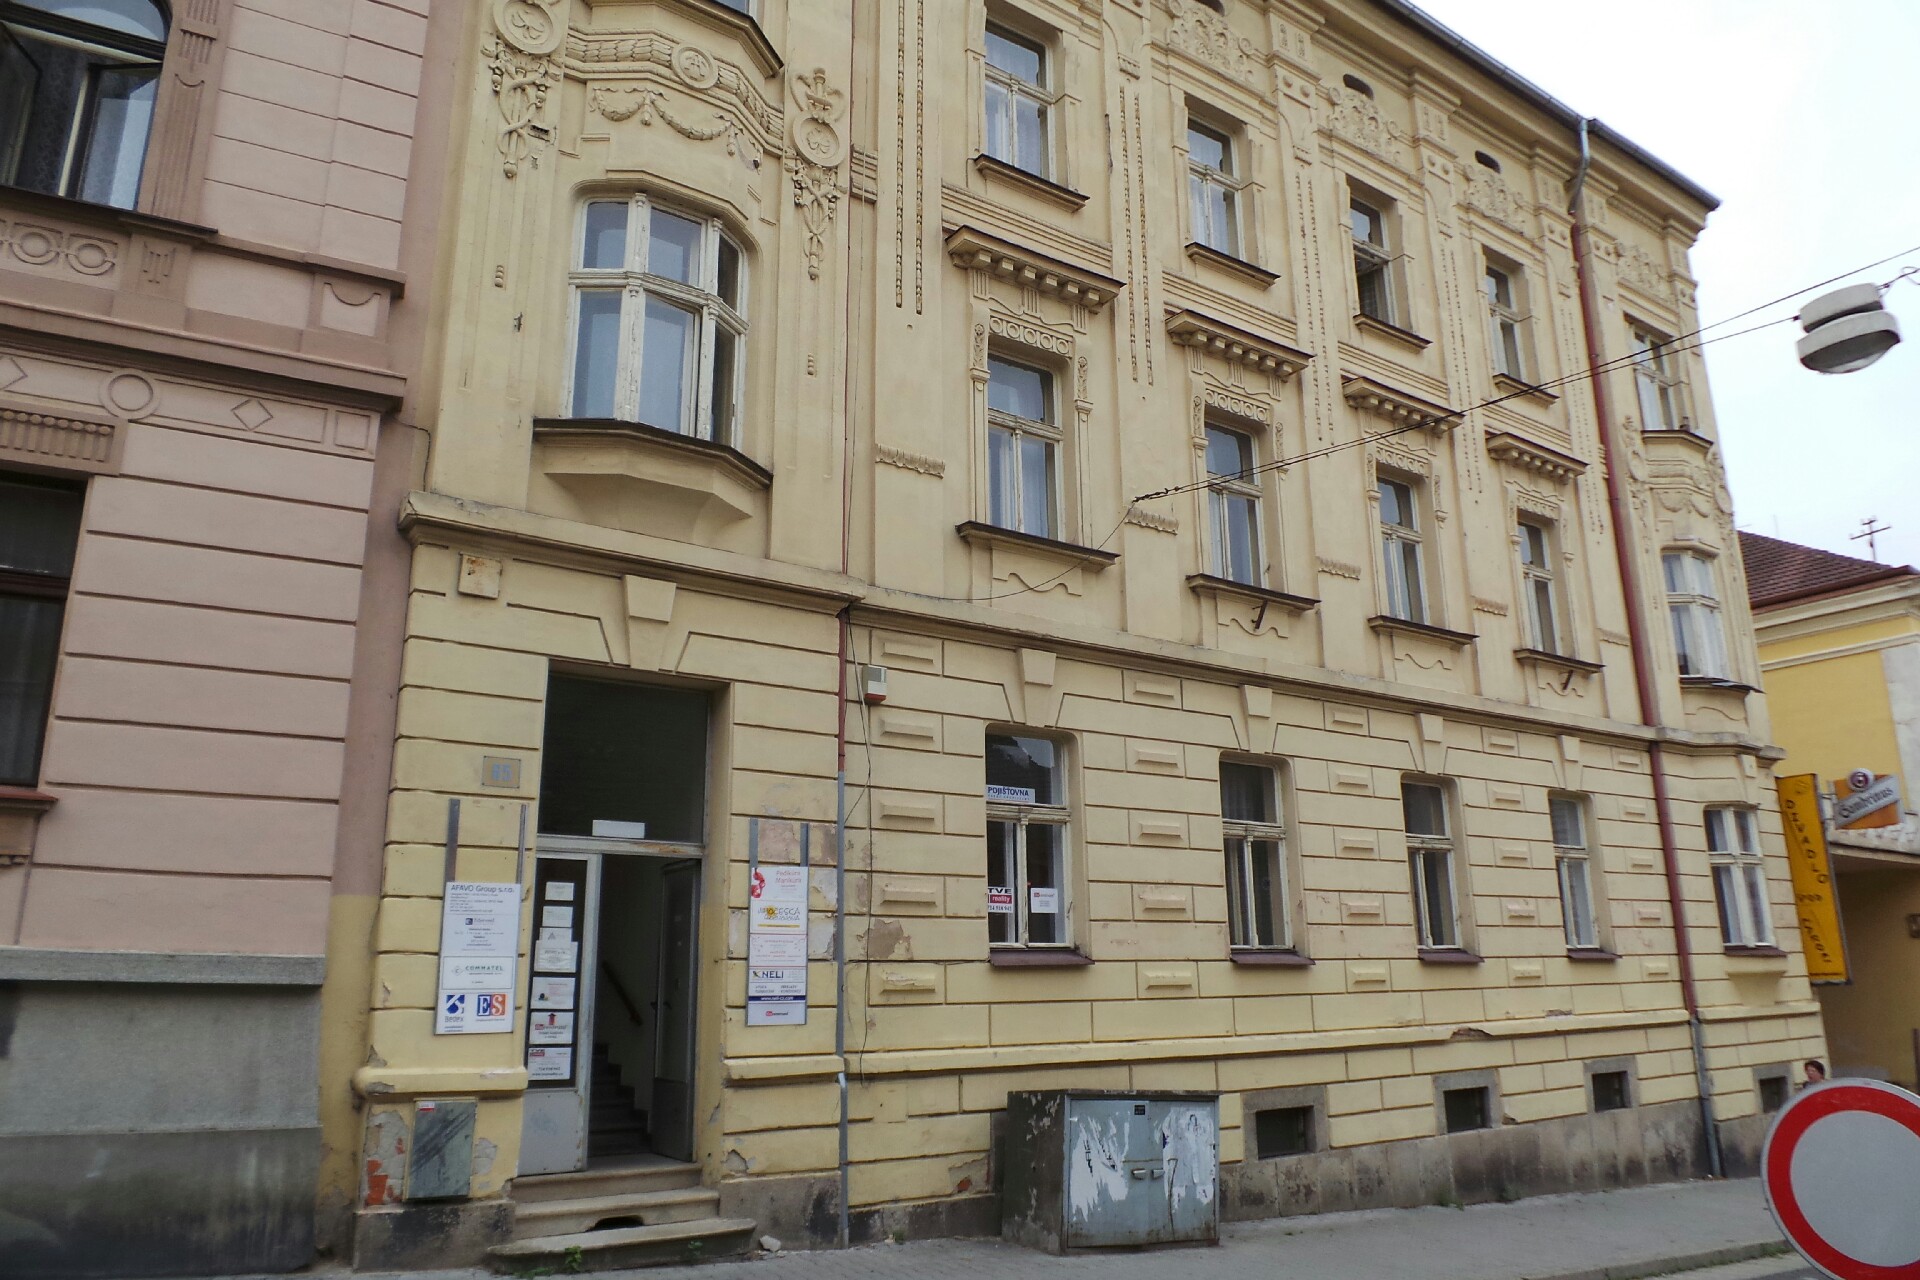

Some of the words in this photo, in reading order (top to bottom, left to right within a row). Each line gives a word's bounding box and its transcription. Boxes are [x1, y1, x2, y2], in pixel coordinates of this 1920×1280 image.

[475, 885, 497, 893] Group
[992, 895, 1010, 904] reality
[762, 970, 784, 979] NELI
